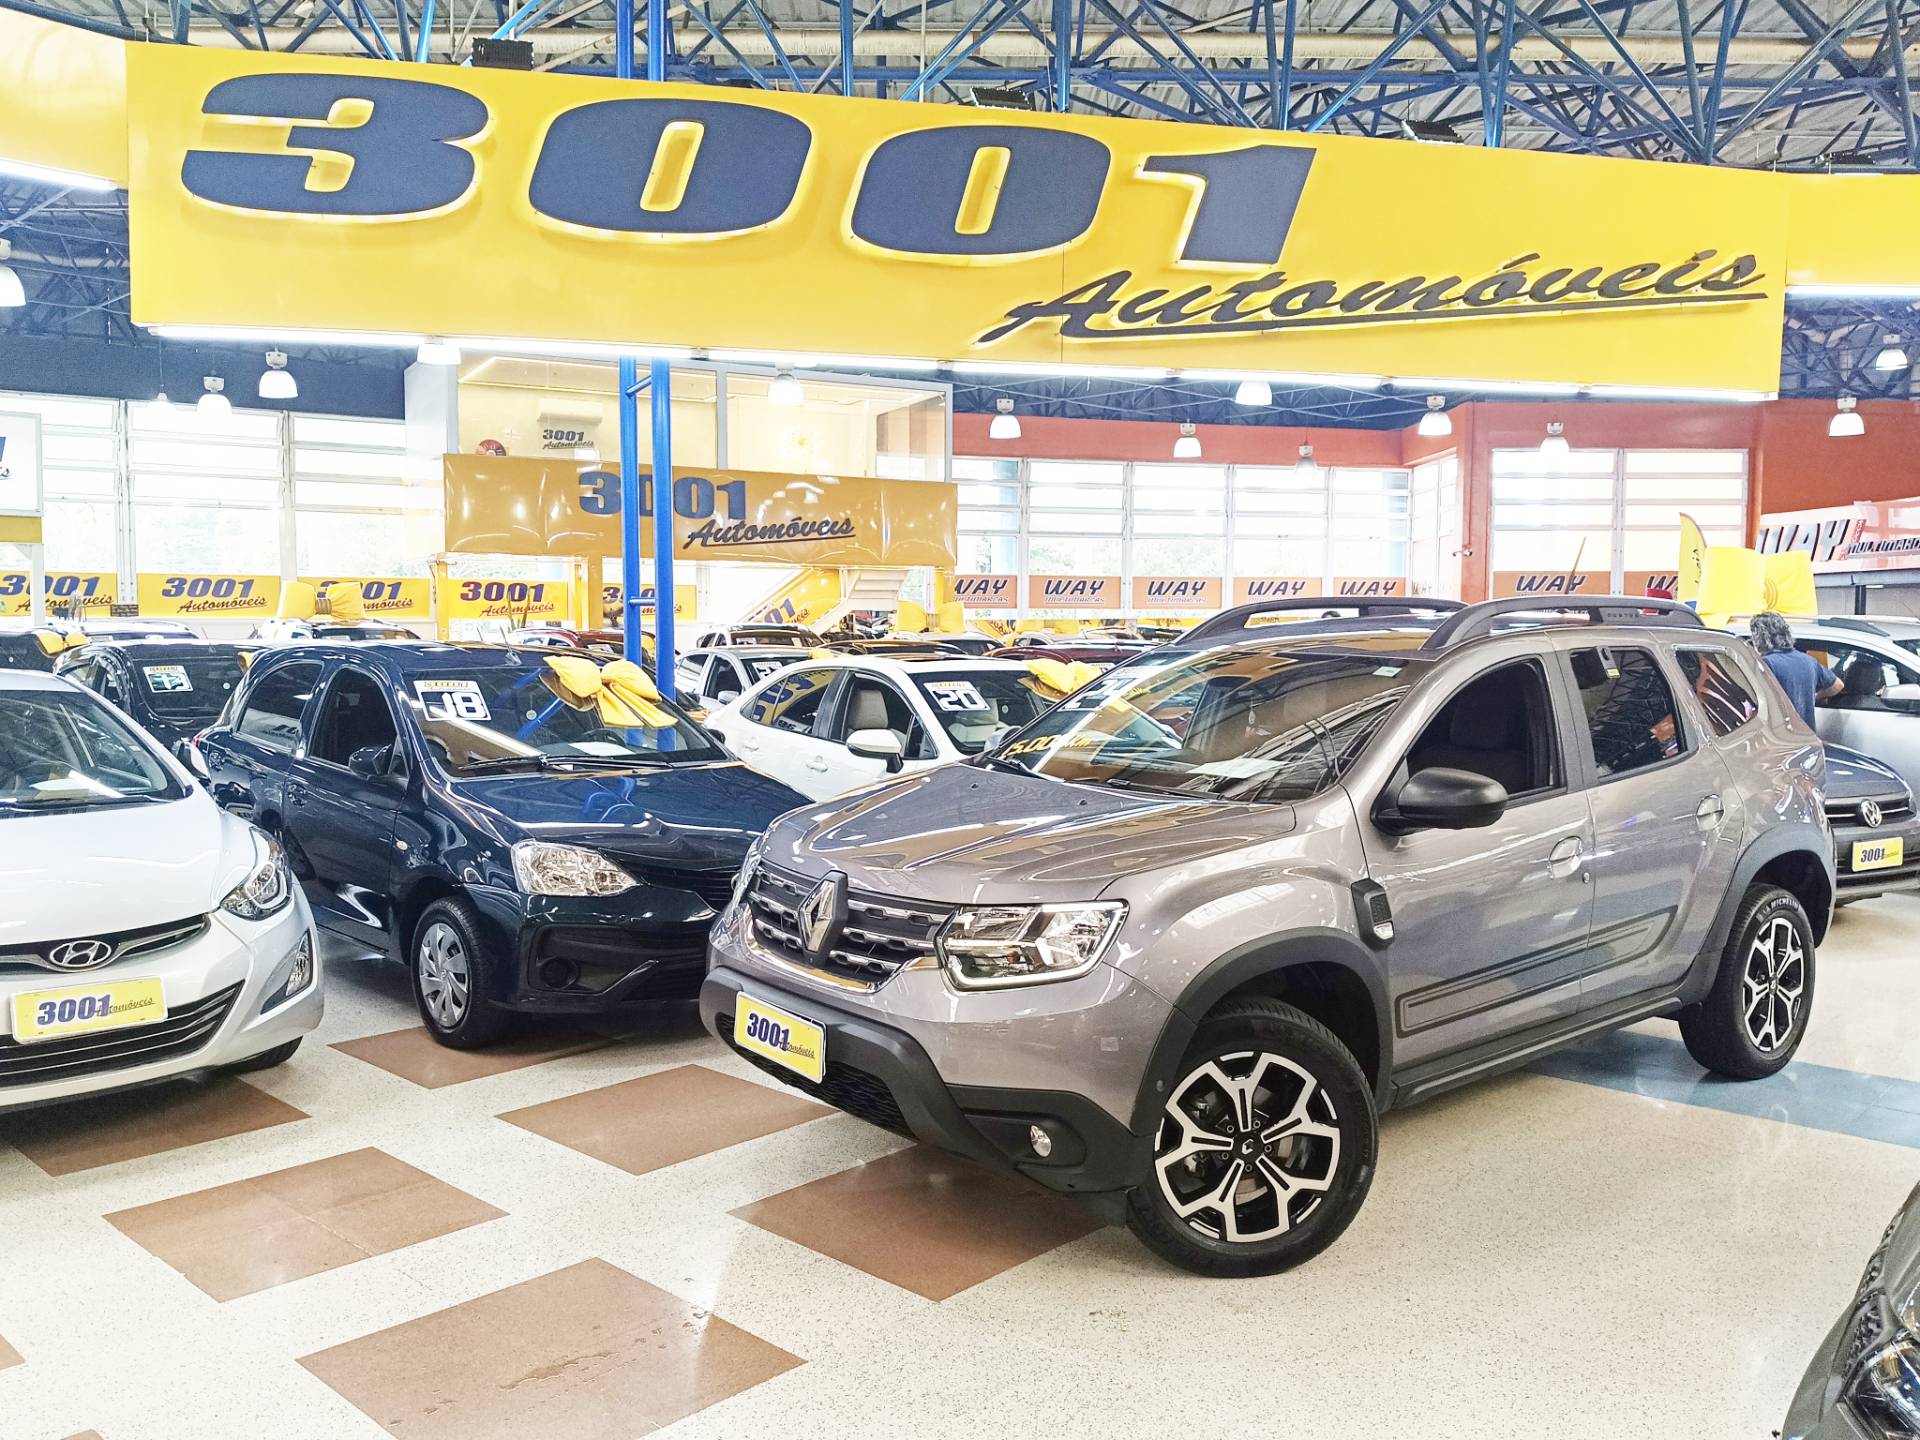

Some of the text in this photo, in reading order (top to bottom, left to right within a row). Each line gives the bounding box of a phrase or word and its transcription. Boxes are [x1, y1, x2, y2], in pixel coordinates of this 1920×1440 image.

[182, 72, 1317, 263] 3001
[977, 249, 1768, 343] Automóveis
[542, 429, 584, 441] 3001
[683, 516, 856, 549] Automóveis
[162, 577, 254, 597] 3001
[460, 581, 544, 602] 3001
[1045, 580, 1104, 594] WAY
[1147, 581, 1206, 595] WAY
[1247, 581, 1306, 595] WAY
[1340, 581, 1397, 595] WAY
[1516, 576, 1586, 591] WAY
[177, 596, 267, 613] Automóveis
[932, 690, 987, 709] 20
[1860, 848, 1885, 863] 3001
[37, 994, 111, 1025] 3001
[747, 1012, 790, 1051] 3001
